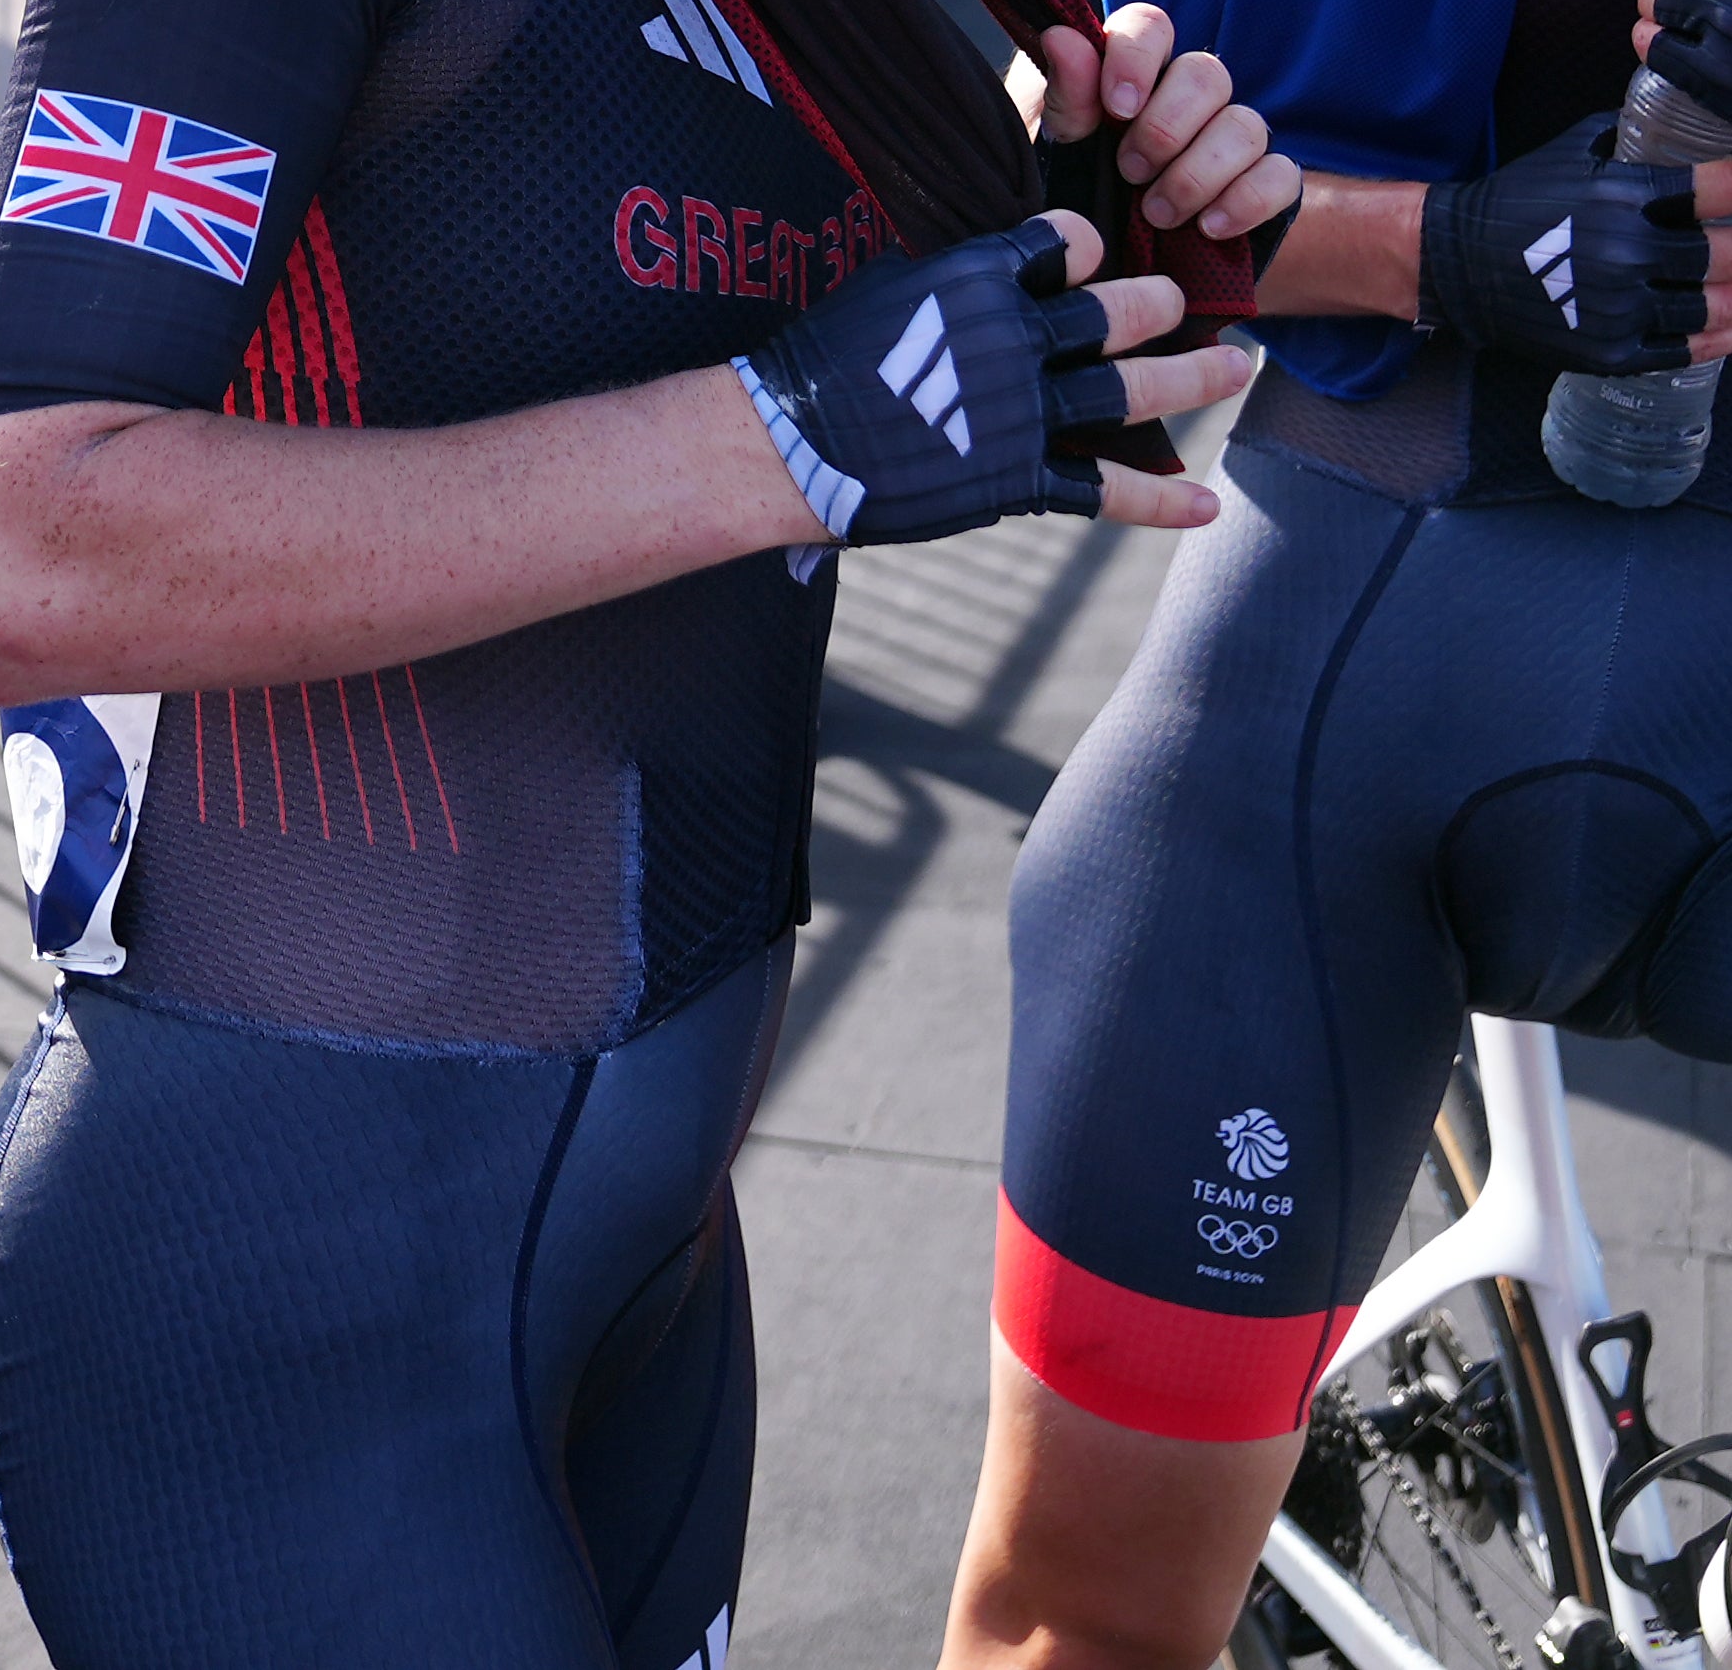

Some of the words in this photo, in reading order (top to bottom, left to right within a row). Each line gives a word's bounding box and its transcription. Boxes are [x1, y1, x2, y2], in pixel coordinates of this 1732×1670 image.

[614, 185, 816, 311] GREAT
[1192, 1179, 1256, 1211] TEAM
[1262, 1194, 1293, 1216] GB
[1233, 1270, 1265, 1285] 2024
